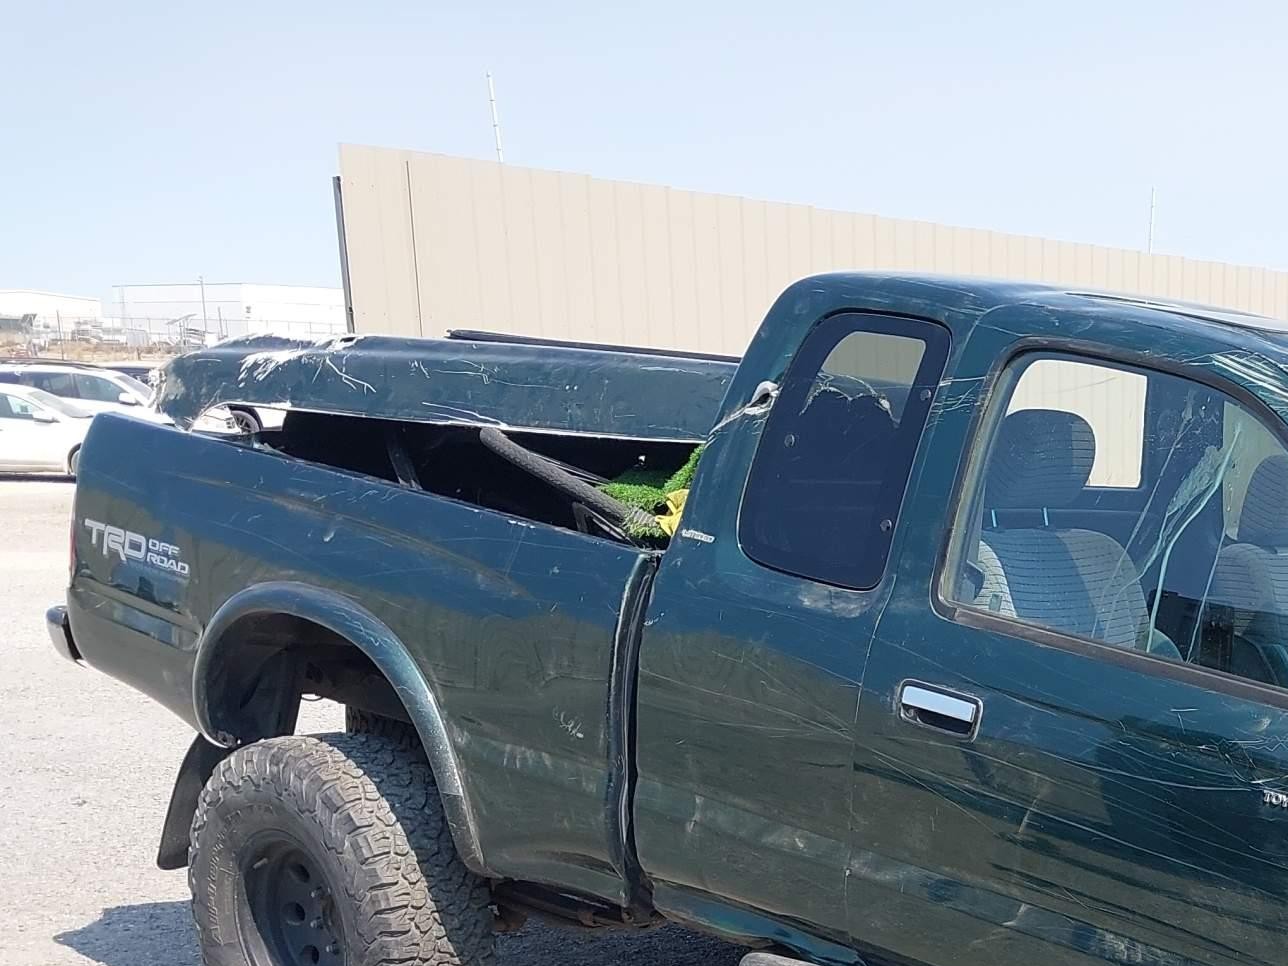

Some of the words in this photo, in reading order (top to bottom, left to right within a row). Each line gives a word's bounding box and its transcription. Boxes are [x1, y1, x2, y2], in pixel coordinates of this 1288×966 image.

[84, 518, 147, 562] TRD
[148, 538, 180, 556] OFF
[146, 552, 190, 575] ROAD
